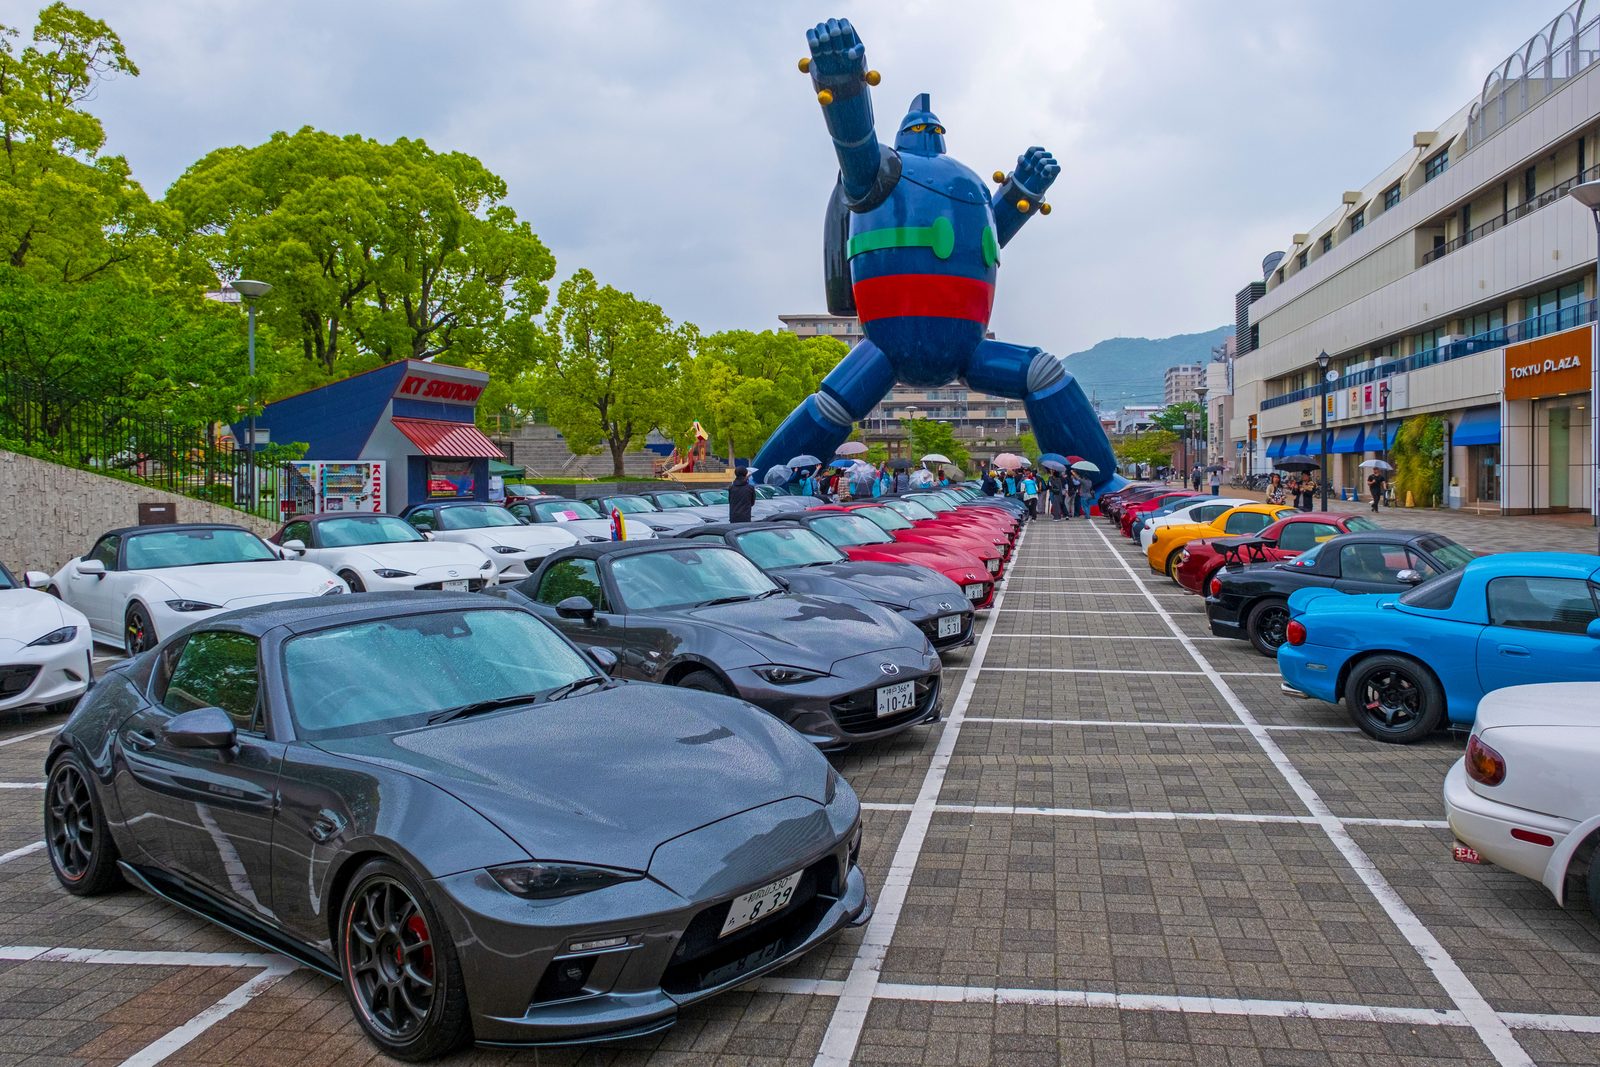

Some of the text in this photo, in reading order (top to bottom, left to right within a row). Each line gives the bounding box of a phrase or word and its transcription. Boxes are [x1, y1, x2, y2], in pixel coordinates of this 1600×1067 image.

[1510, 355, 1581, 379] TOKYU PLAZA
[401, 376, 483, 402] KT STATION
[373, 464, 381, 512] KIRIN
[887, 692, 913, 712] 10-24
